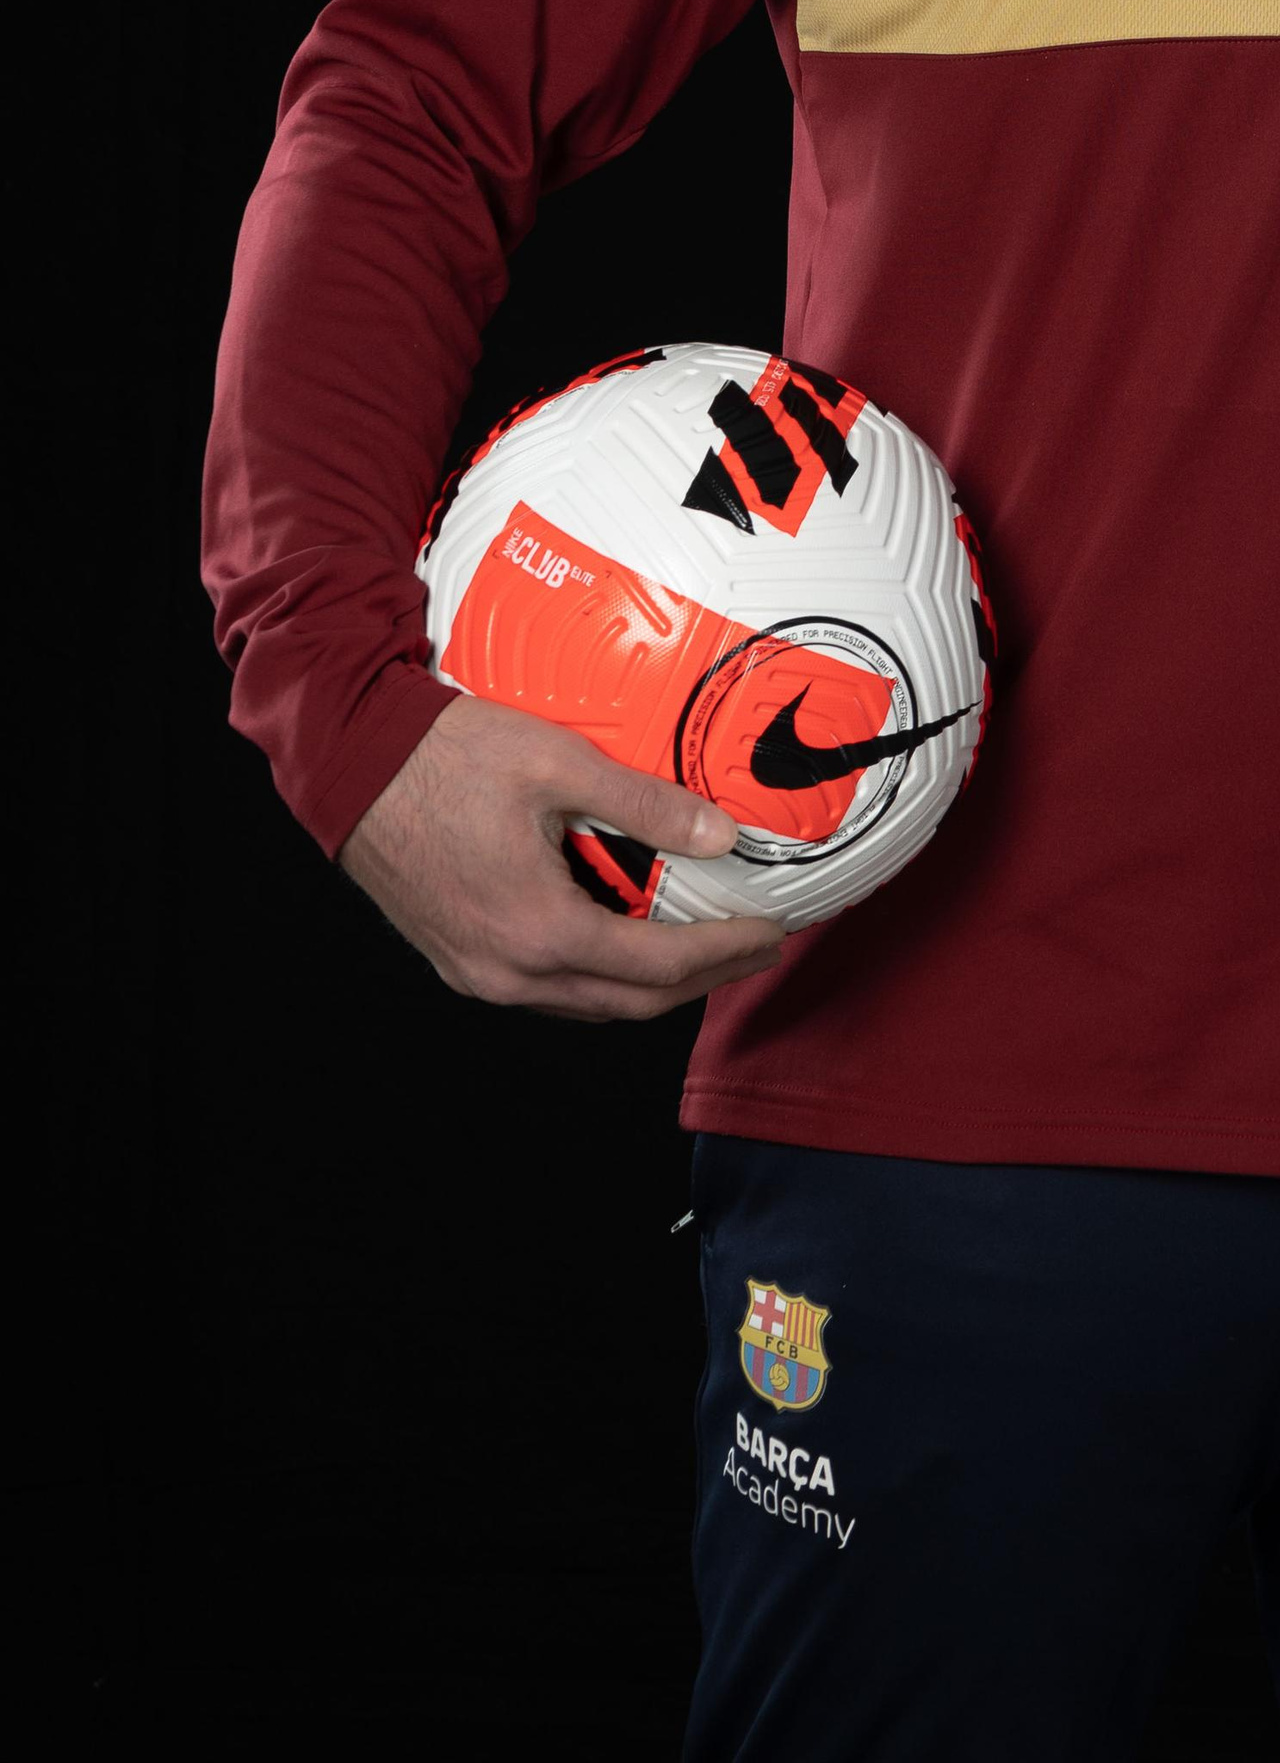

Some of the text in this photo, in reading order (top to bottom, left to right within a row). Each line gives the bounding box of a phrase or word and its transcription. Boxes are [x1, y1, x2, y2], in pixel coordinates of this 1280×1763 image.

[502, 527, 596, 589] NIKE CLUB ELITE
[691, 690, 716, 736] PRECISION
[802, 629, 819, 638] FOR
[823, 629, 868, 652] PRECISION
[866, 649, 893, 675] FLIGHT
[892, 676, 908, 729] ENGINEERED
[736, 838, 776, 856] PRECISIO
[765, 1336, 799, 1359] FCB
[736, 1412, 836, 1497] BARÇA
[723, 1446, 856, 1550] Academy
